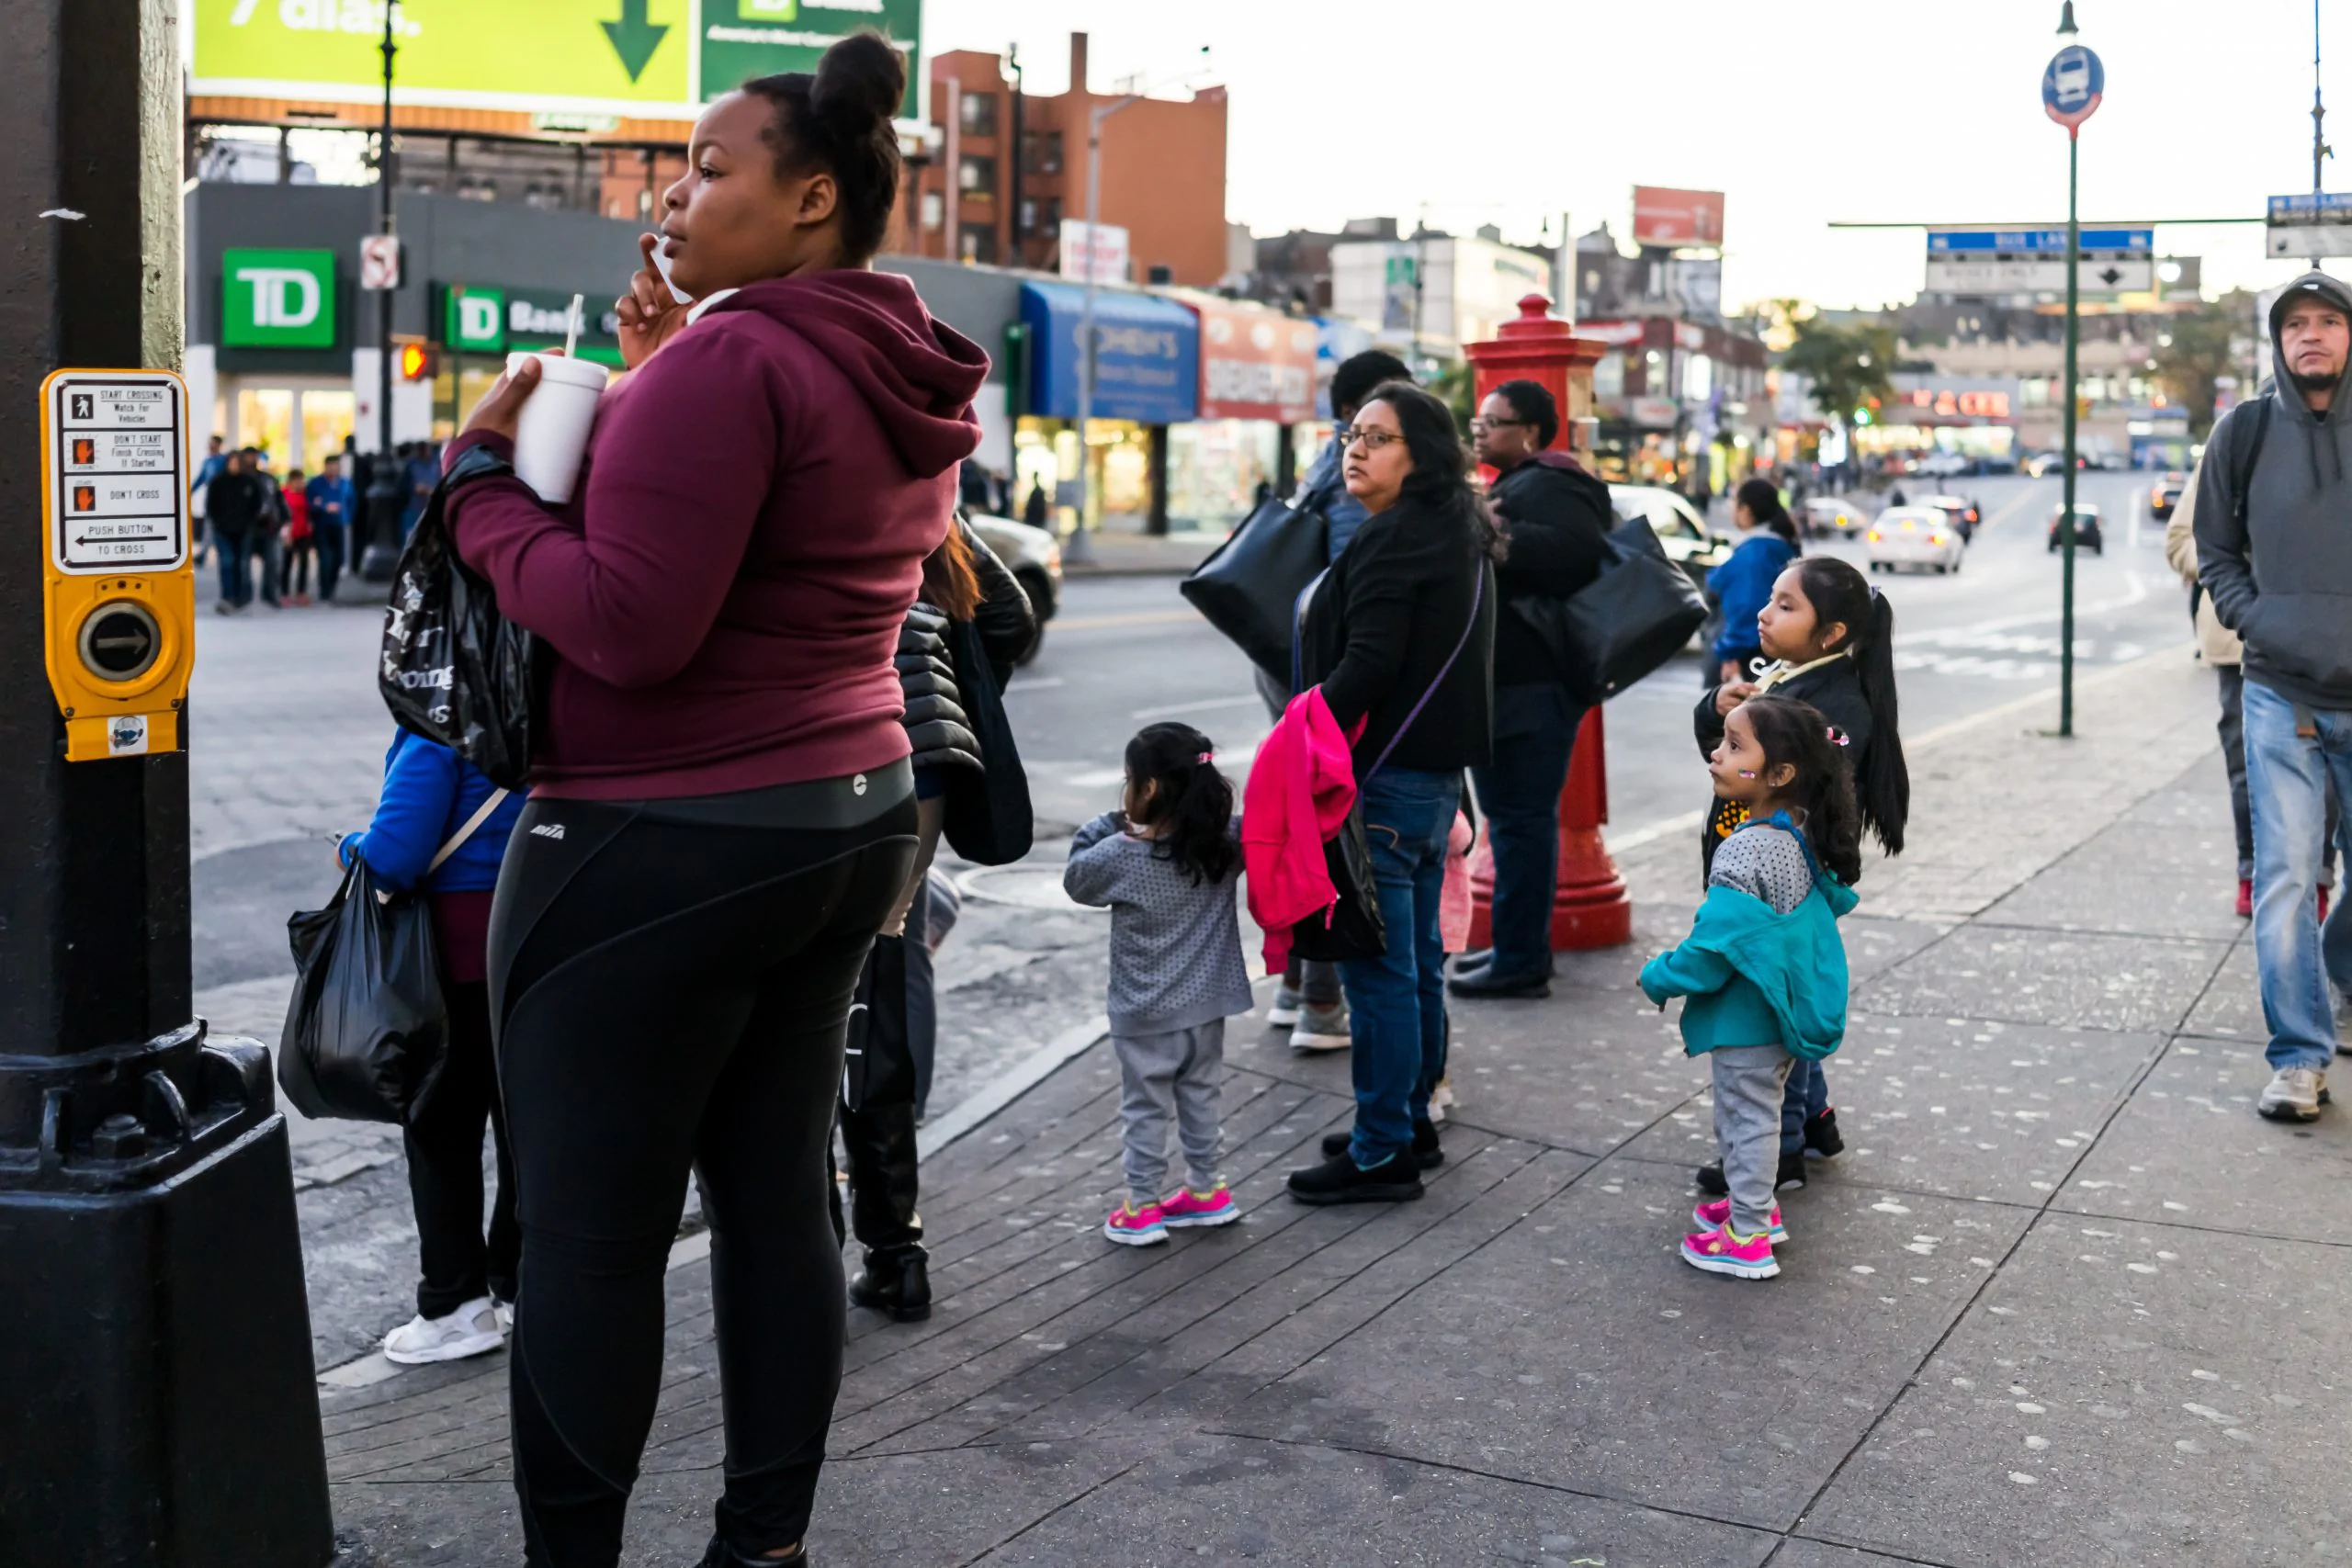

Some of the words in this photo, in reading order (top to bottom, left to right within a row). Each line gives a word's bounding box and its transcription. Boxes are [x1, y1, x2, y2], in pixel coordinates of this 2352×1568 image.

[236, 268, 321, 327] TD
[458, 296, 499, 340] TD
[100, 389, 122, 400] START
[126, 390, 163, 400] CROSSING
[114, 403, 134, 412] Watch
[119, 414, 146, 423] Vehicles
[114, 434, 136, 445] DON'T
[140, 434, 162, 444] START
[136, 447, 165, 458] Crossing
[131, 459, 155, 468] Started
[110, 491, 132, 500] DON'T
[136, 490, 160, 500] CROSS
[88, 525, 114, 536] PUSH
[118, 525, 153, 535] BUTTON
[97, 546, 110, 555] TO
[114, 544, 145, 555] CROSS
